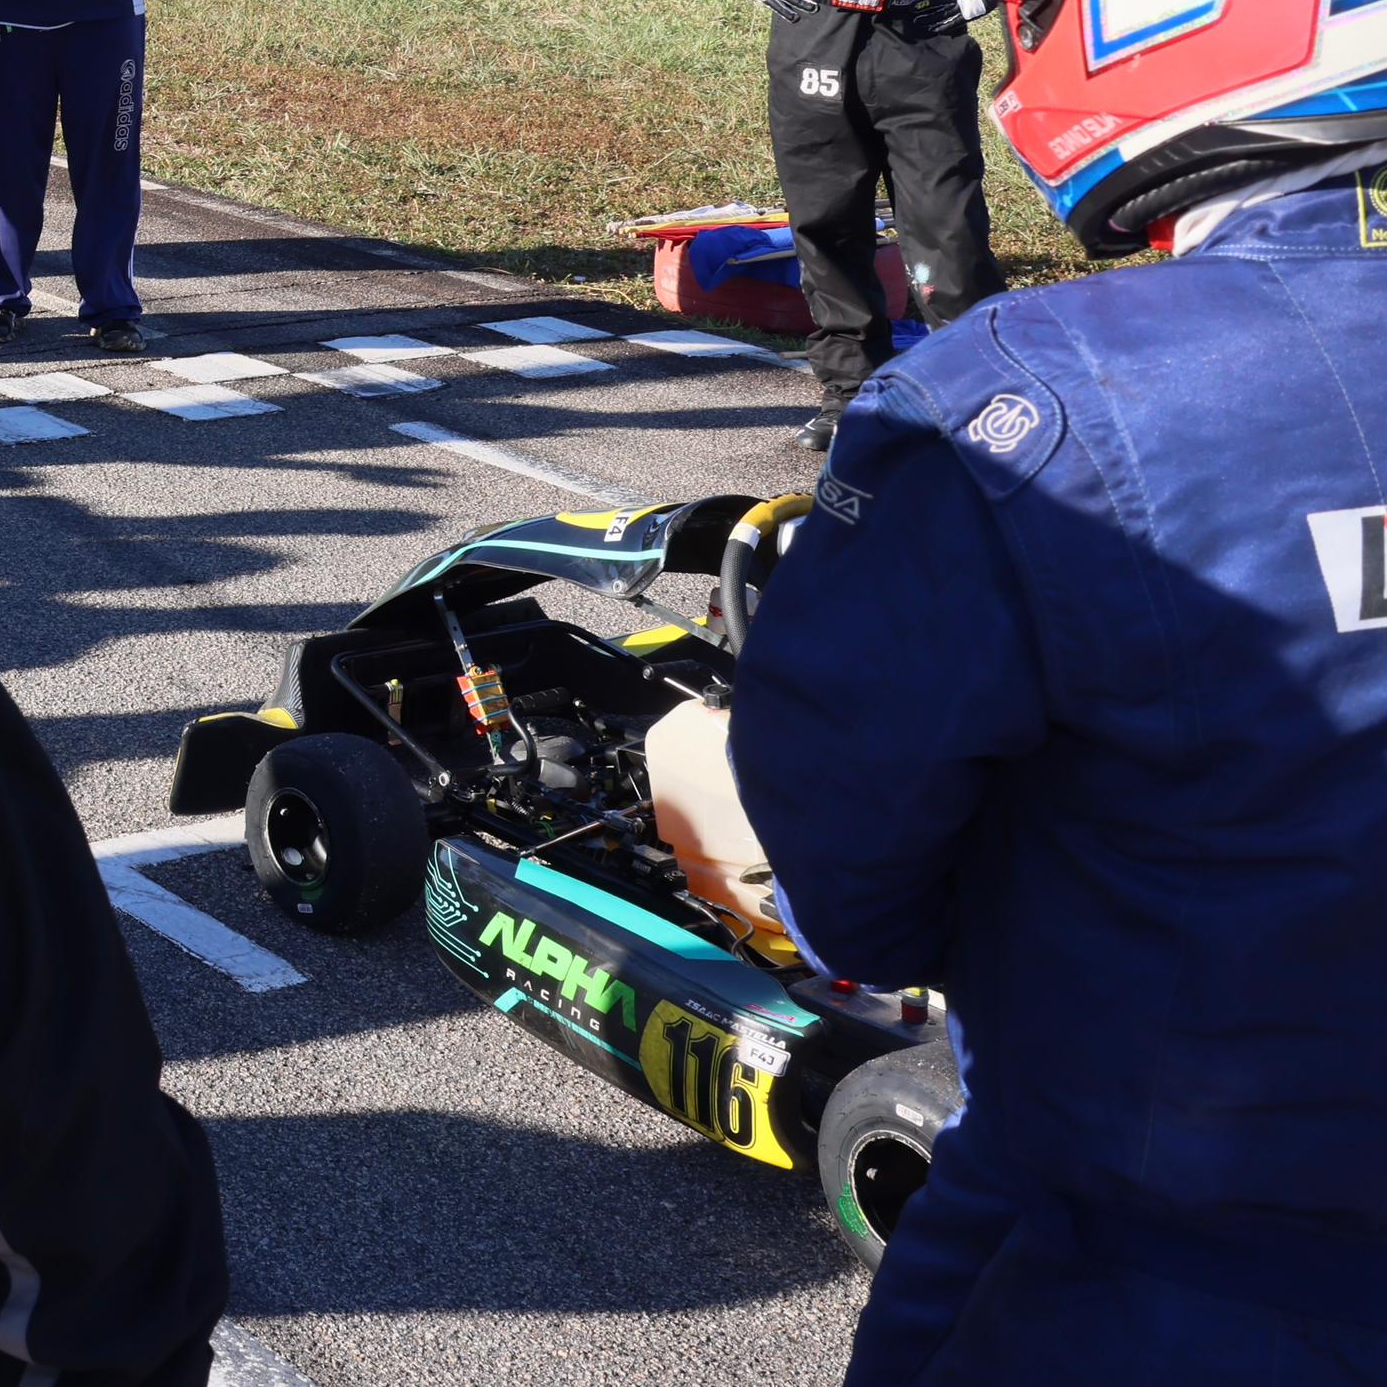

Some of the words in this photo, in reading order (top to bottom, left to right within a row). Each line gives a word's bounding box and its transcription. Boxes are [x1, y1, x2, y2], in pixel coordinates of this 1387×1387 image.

[114, 80, 134, 151] adidas
[800, 68, 839, 97] 85
[478, 911, 638, 1033] ALPHA
[506, 967, 601, 1032] RACING
[685, 999, 722, 1022] ISAAC
[721, 1017, 787, 1050] MASTELLA
[662, 1015, 759, 1150] 116
